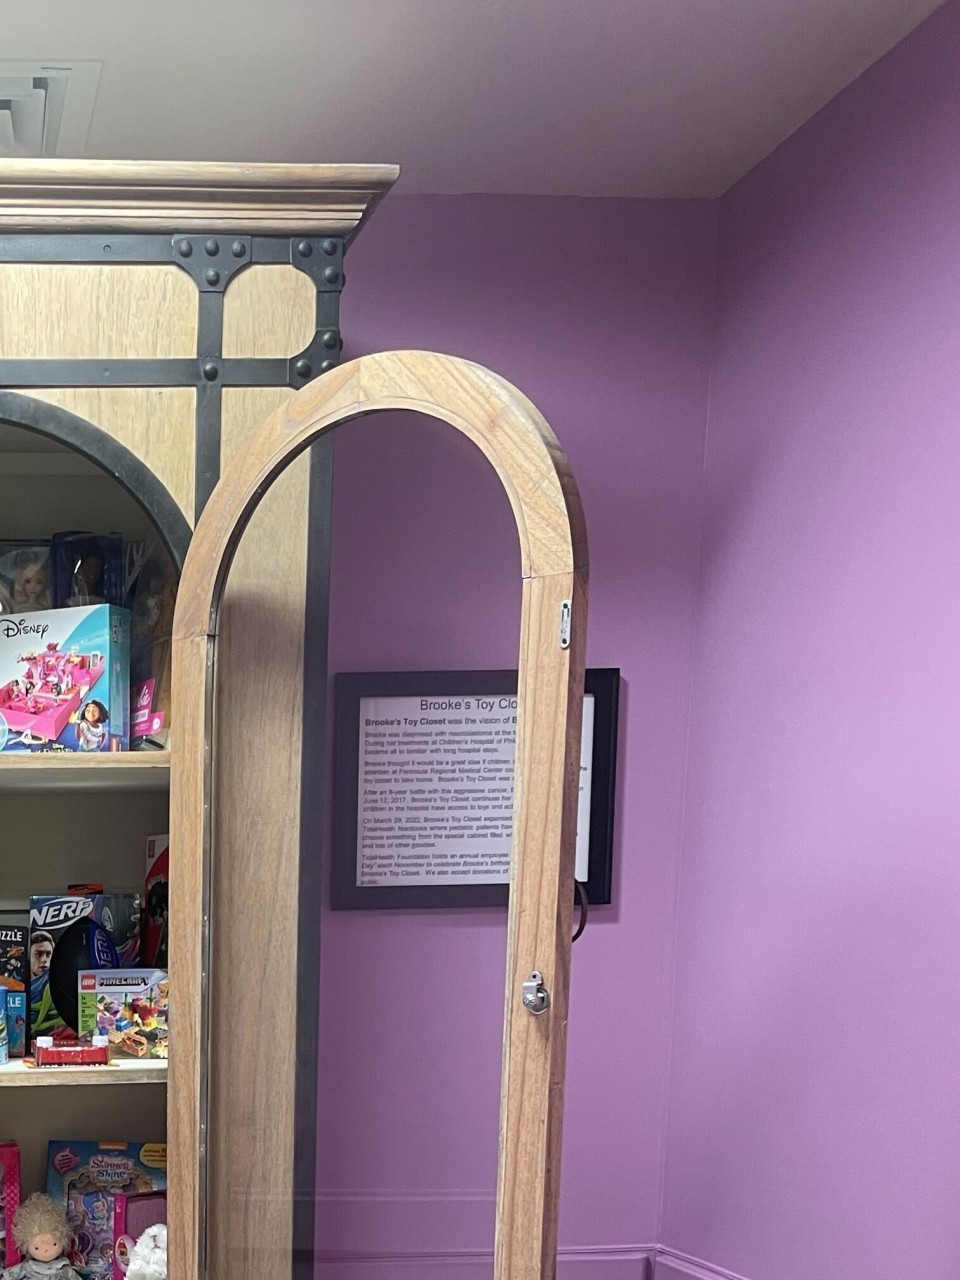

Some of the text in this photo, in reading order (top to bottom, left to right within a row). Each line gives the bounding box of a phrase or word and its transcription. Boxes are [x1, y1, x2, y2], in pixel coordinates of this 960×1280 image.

[0, 619, 50, 640] Disney
[420, 698, 518, 712] Brooke's Toy Clo
[365, 718, 401, 726] Brooke's
[403, 718, 418, 727] Toy
[420, 718, 446, 726] Closet
[30, 901, 94, 926] NERF
[98, 976, 150, 986] MINECRAFT
[96, 1169, 126, 1180] Shine
